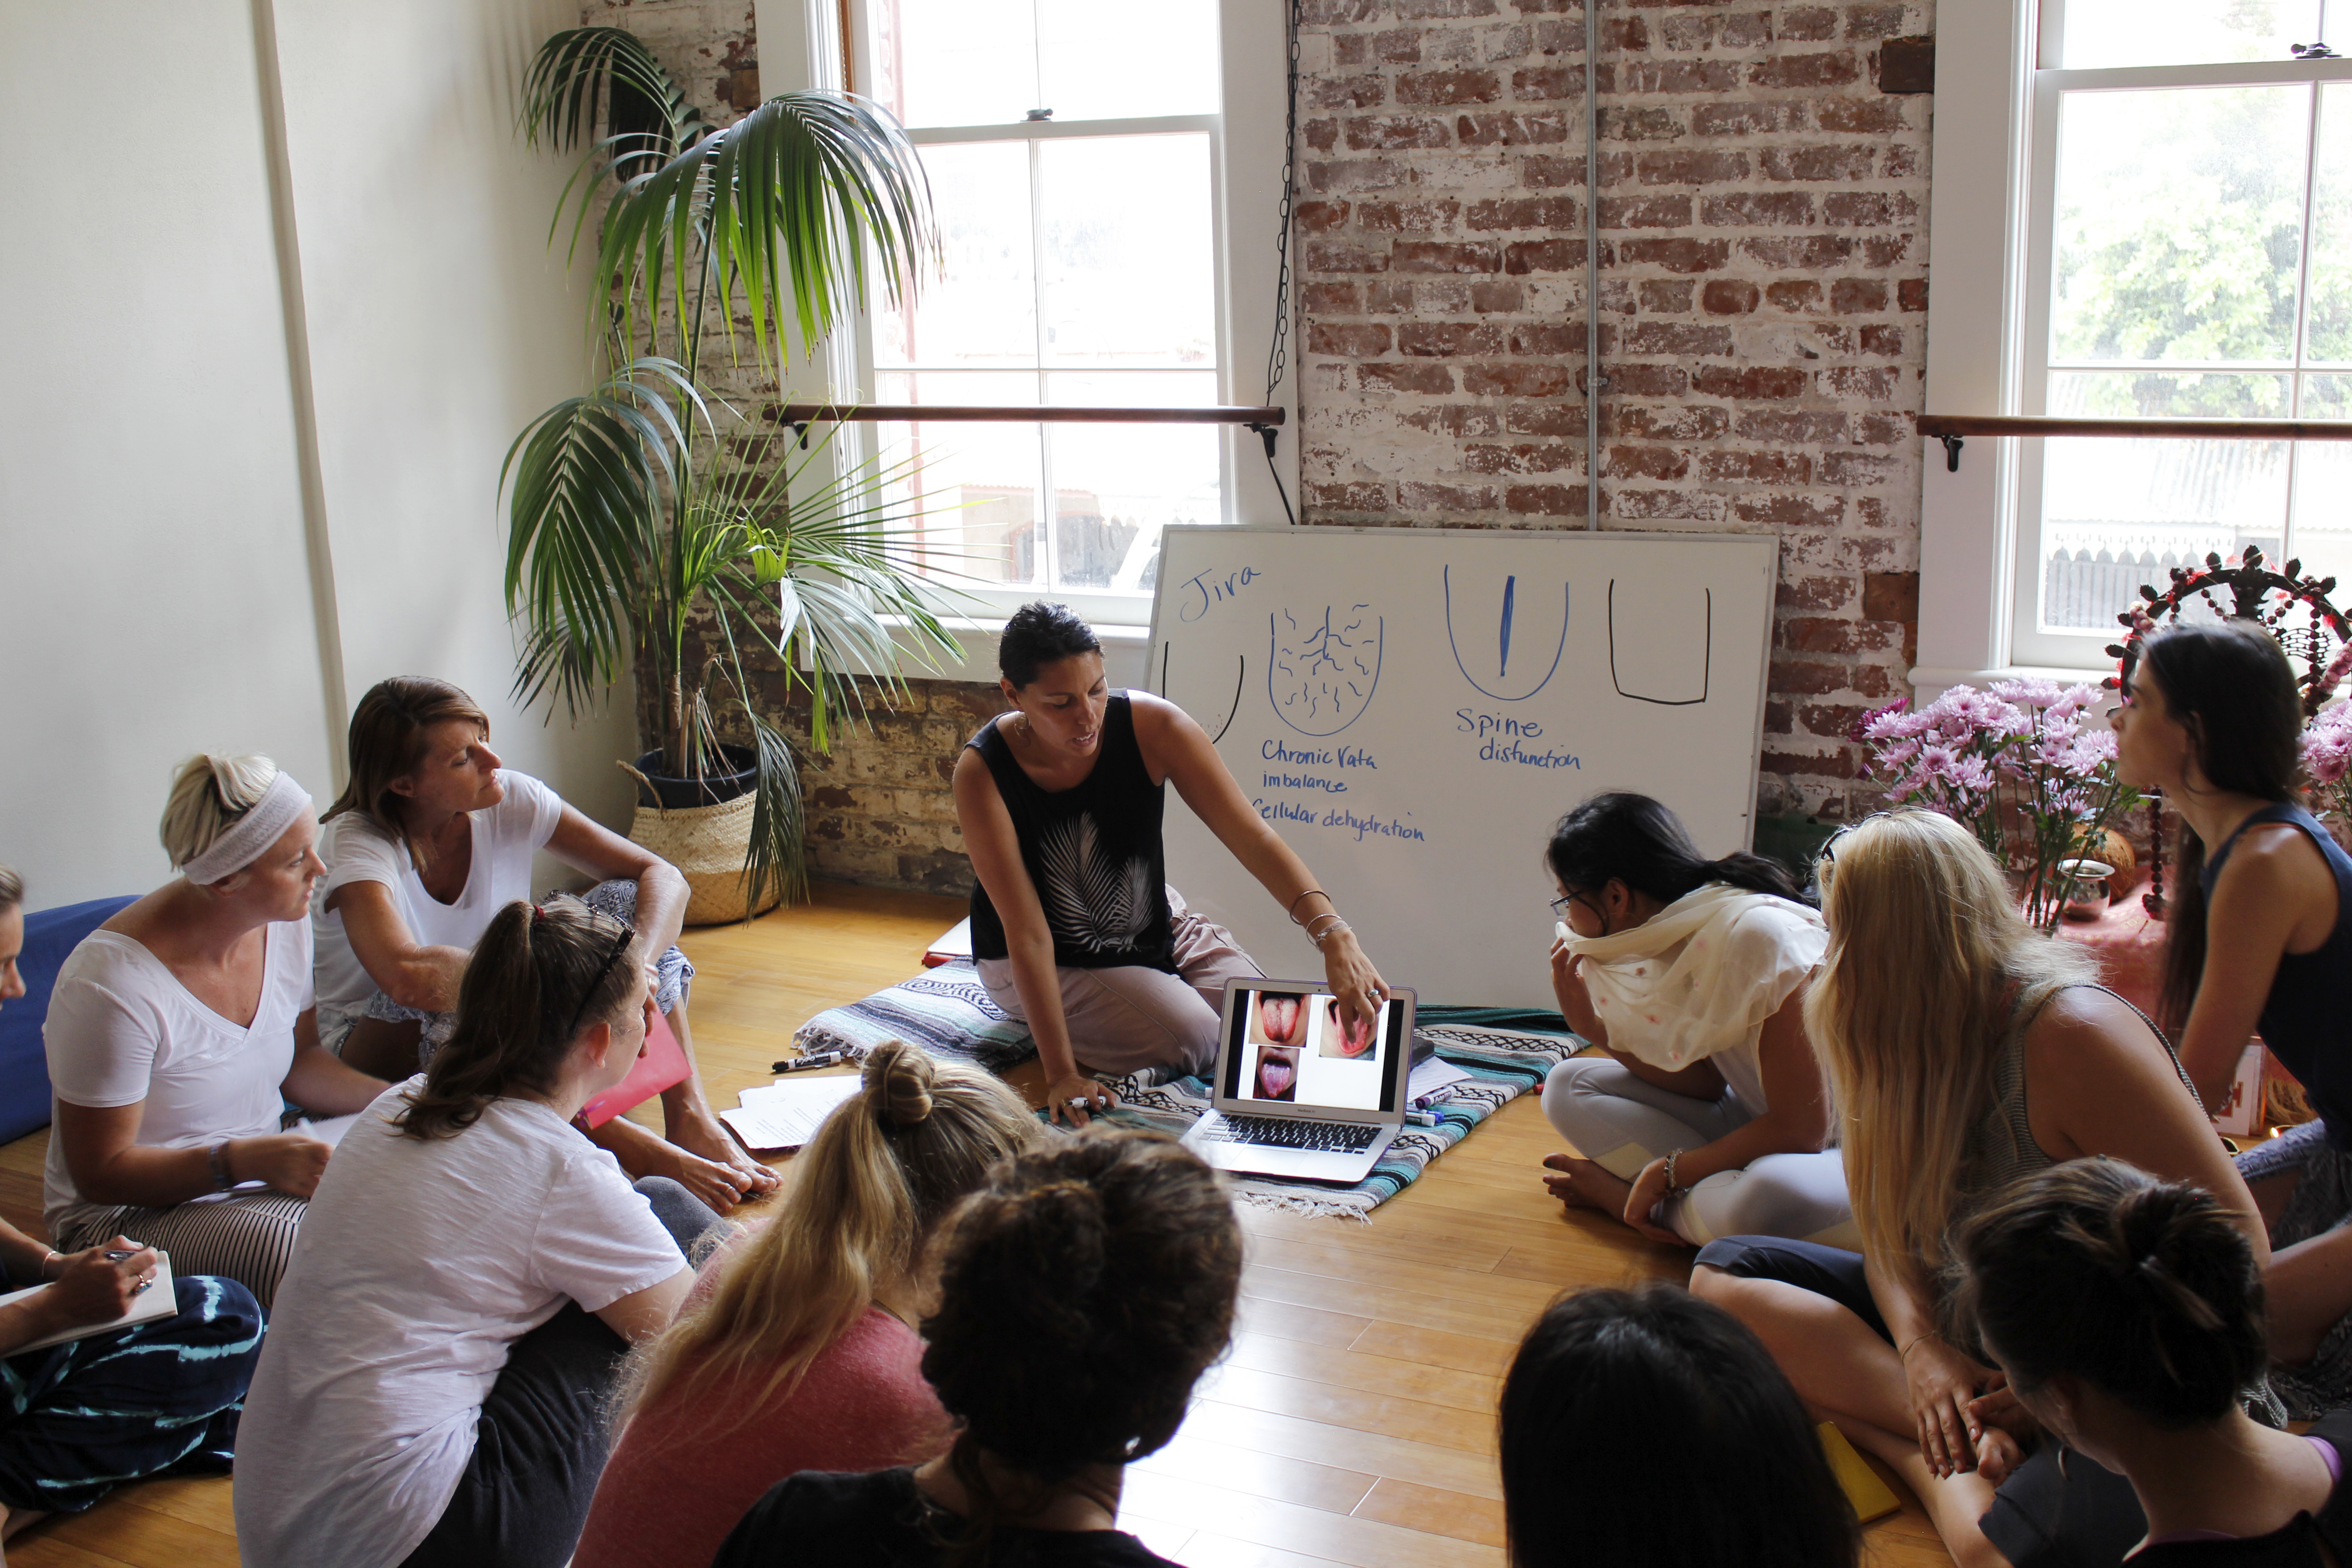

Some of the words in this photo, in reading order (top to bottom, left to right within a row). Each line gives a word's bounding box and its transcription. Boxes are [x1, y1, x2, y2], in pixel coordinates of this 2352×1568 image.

[1180, 567, 1261, 622] Jira
[1456, 708, 1543, 738] Spine
[1262, 740, 1333, 764] Chronic
[1338, 745, 1377, 769] Vata
[1480, 737, 1581, 770] disfunction
[1263, 771, 1348, 793] imbalance
[1322, 808, 1425, 842] dehydration
[796, 1055, 815, 1065] EXPO
